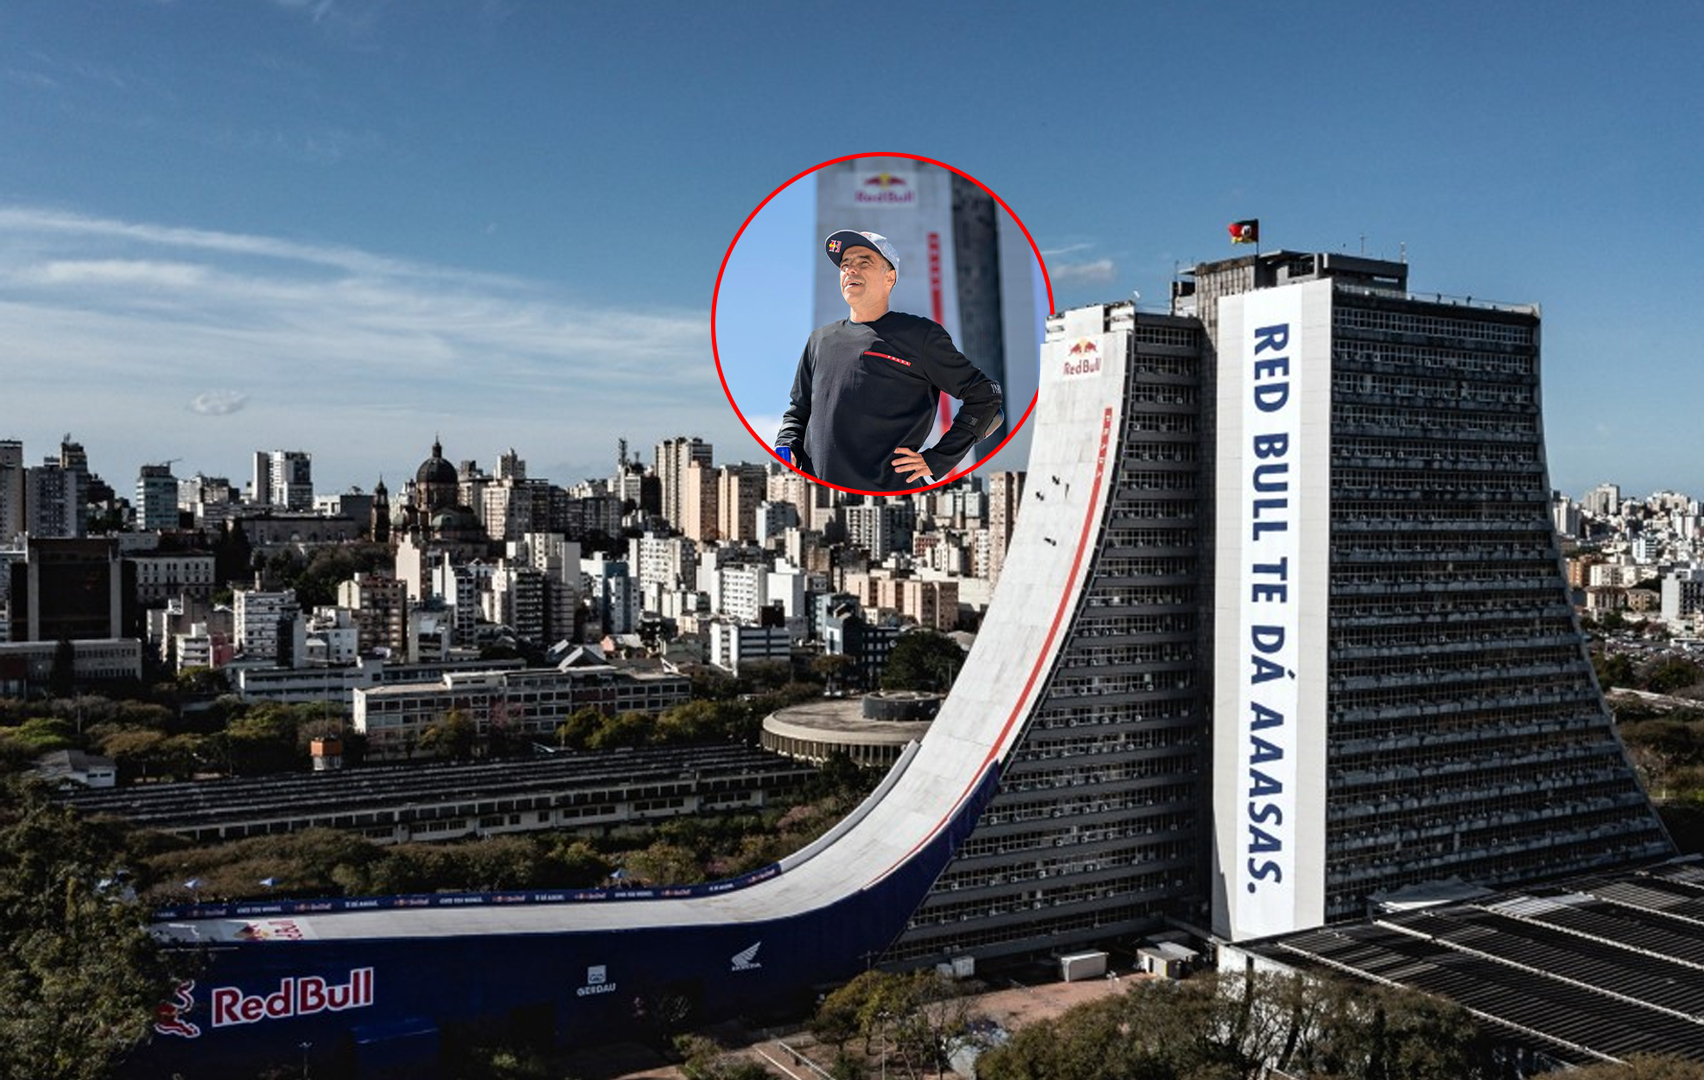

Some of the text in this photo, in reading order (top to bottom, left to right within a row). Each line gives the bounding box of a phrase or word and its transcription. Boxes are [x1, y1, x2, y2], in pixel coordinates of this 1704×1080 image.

[1248, 323, 1295, 894] RED BULL TE DÁ AAASAS.
